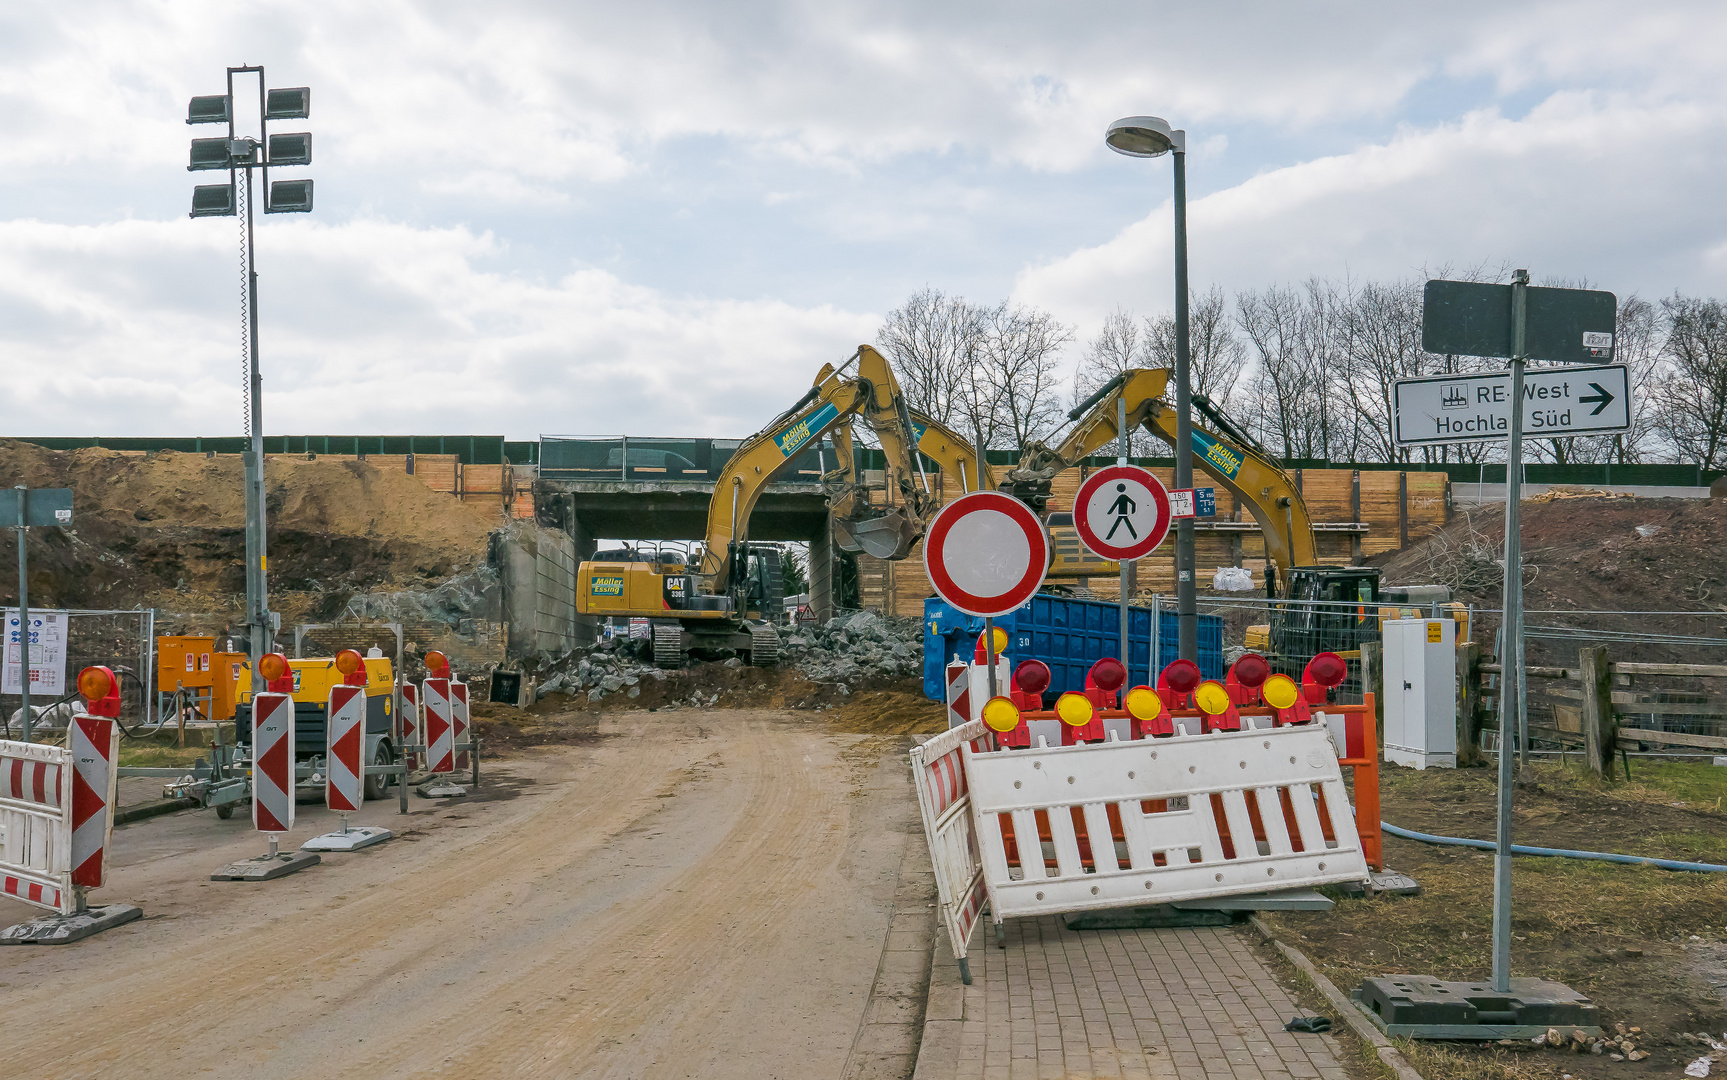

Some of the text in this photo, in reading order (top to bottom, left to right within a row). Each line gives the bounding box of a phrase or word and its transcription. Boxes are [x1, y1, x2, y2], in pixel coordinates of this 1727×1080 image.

[1477, 382, 1570, 403] REWest
[782, 420, 806, 444] Möller
[1436, 409, 1572, 433] Hochla Süd
[786, 428, 810, 451] Essing
[1207, 450, 1234, 474] Essing
[1213, 442, 1241, 466] Möller
[594, 585, 620, 595] Essing
[595, 577, 622, 585] Möller
[667, 577, 685, 590] CAT
[1019, 637, 1030, 647] 30
